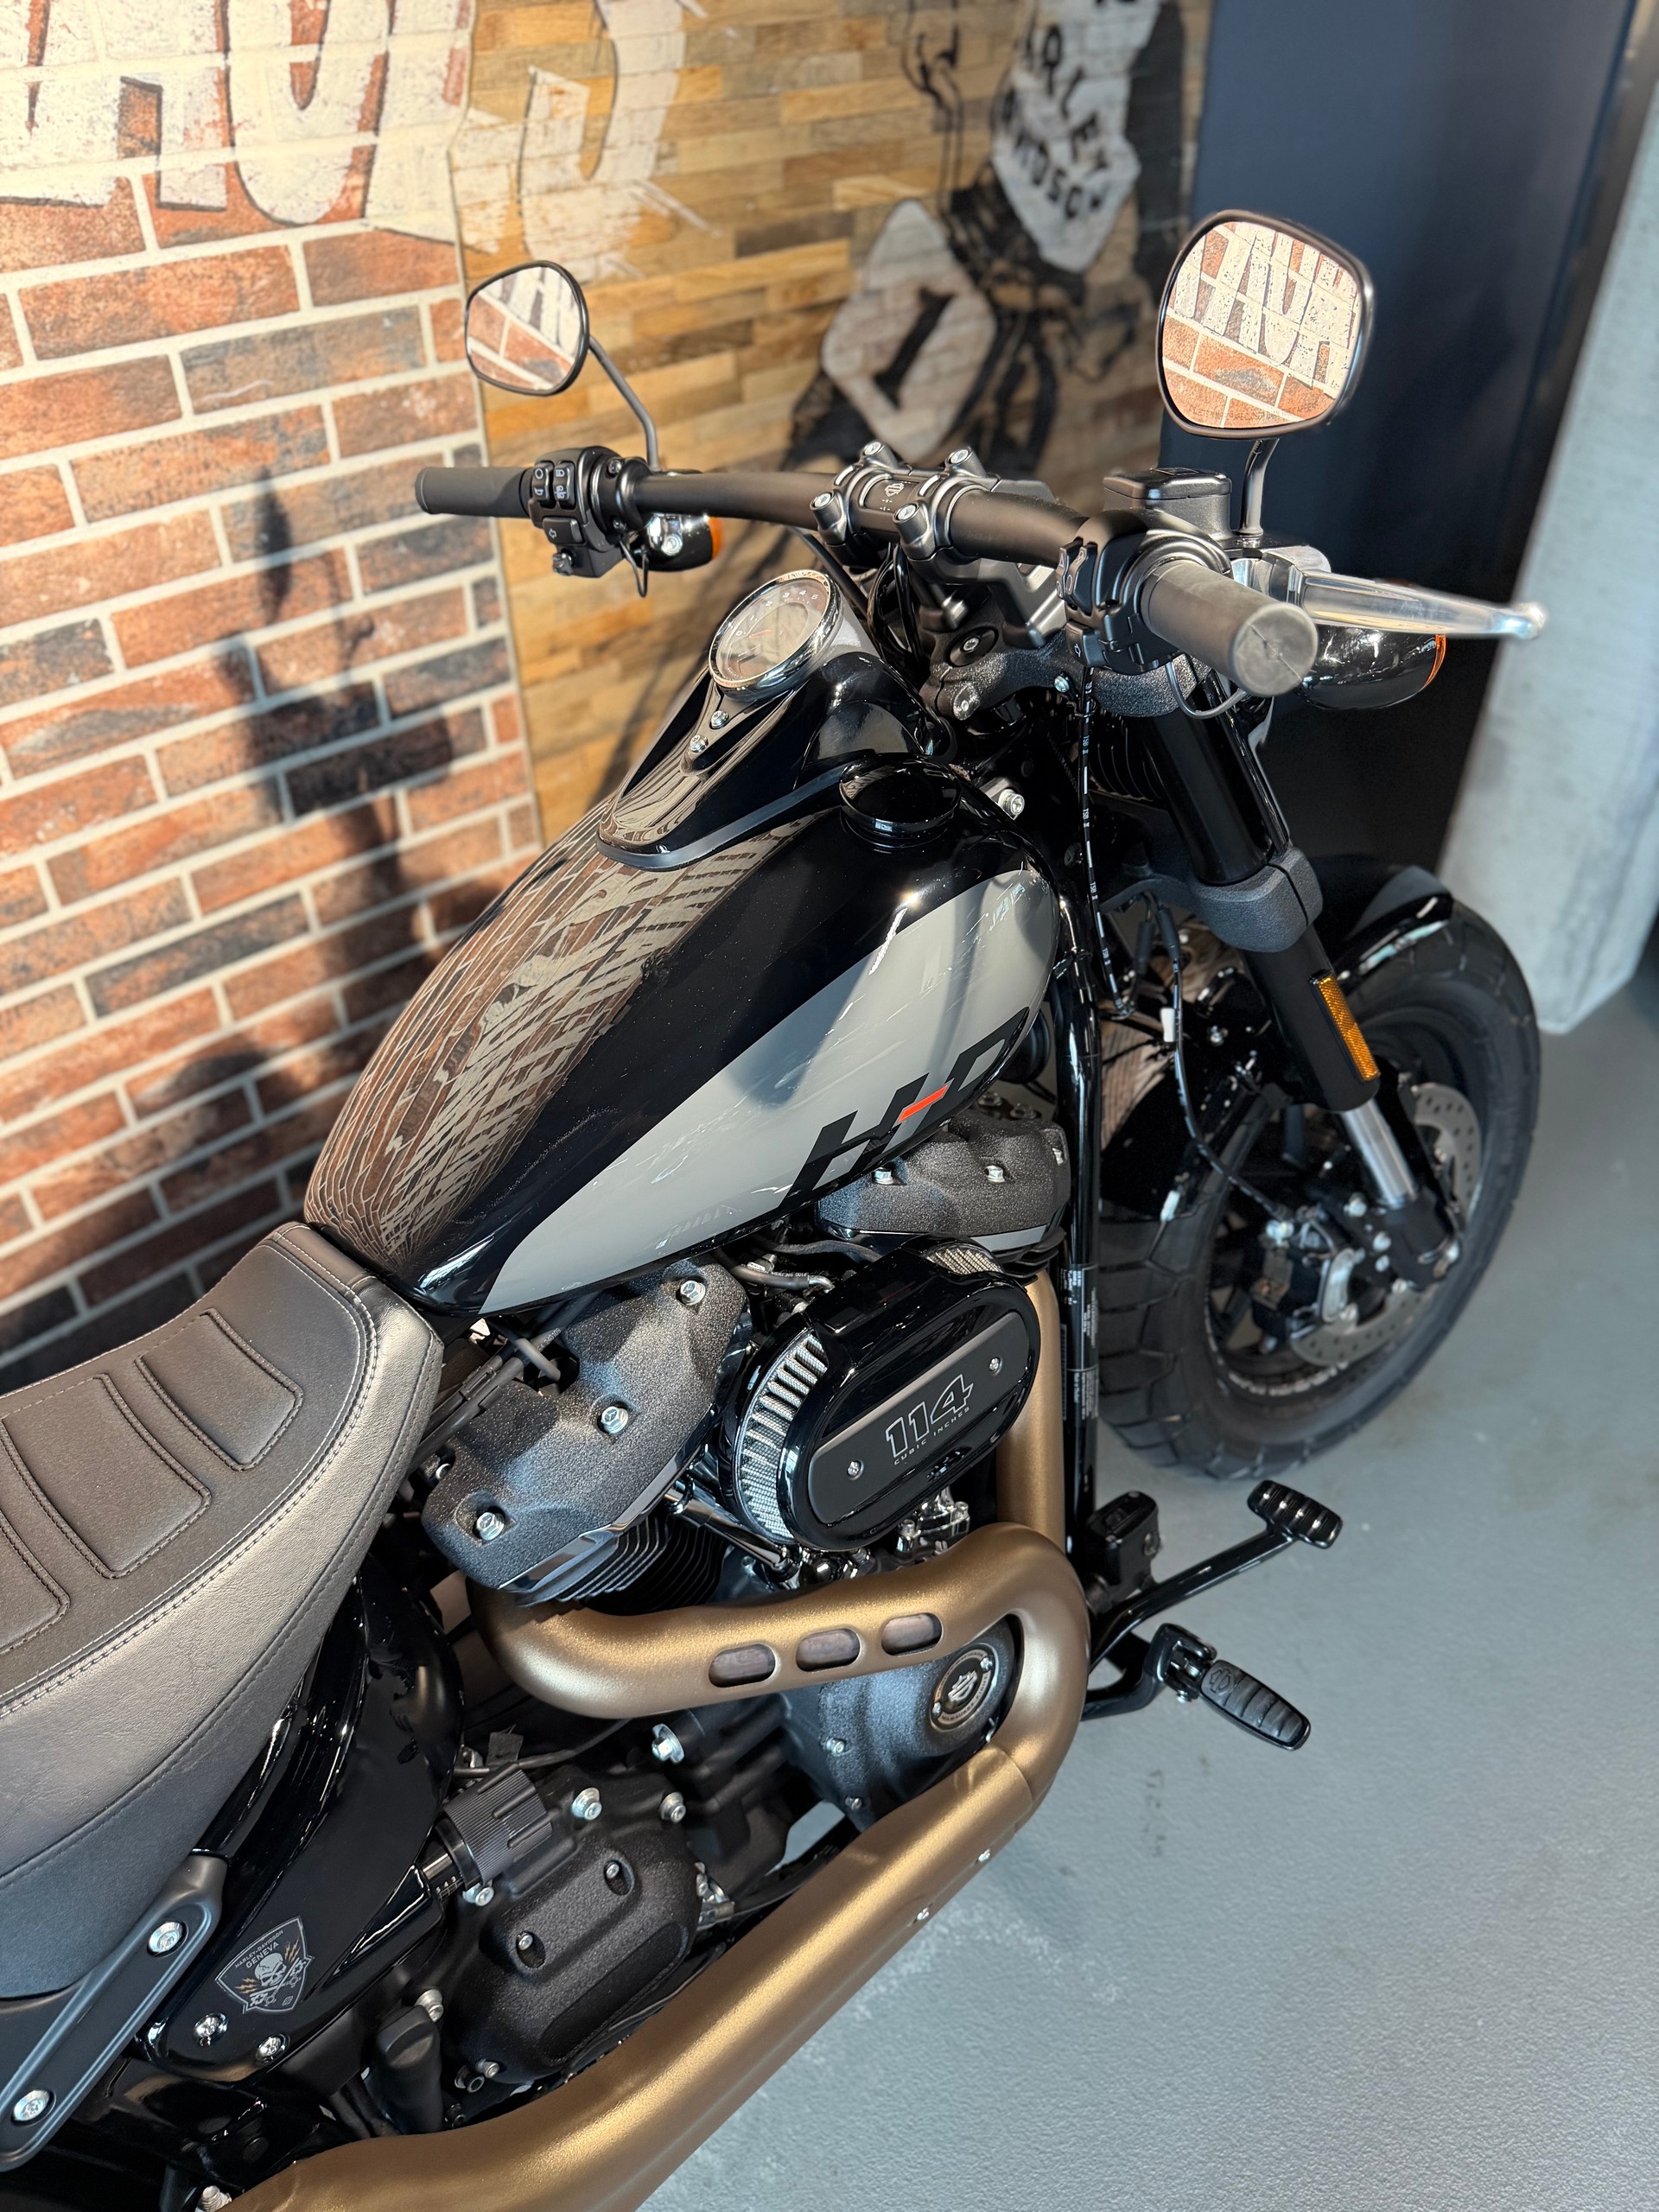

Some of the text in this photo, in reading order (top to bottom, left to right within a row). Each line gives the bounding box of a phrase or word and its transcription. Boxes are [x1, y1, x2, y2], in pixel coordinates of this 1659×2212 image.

[885, 1373, 974, 1458] 114
[893, 1406, 970, 1465] CUBIC INCHES
[234, 1929, 284, 1968] HARLEY-DAVIDSON
[245, 1941, 280, 1968] GENEVA
